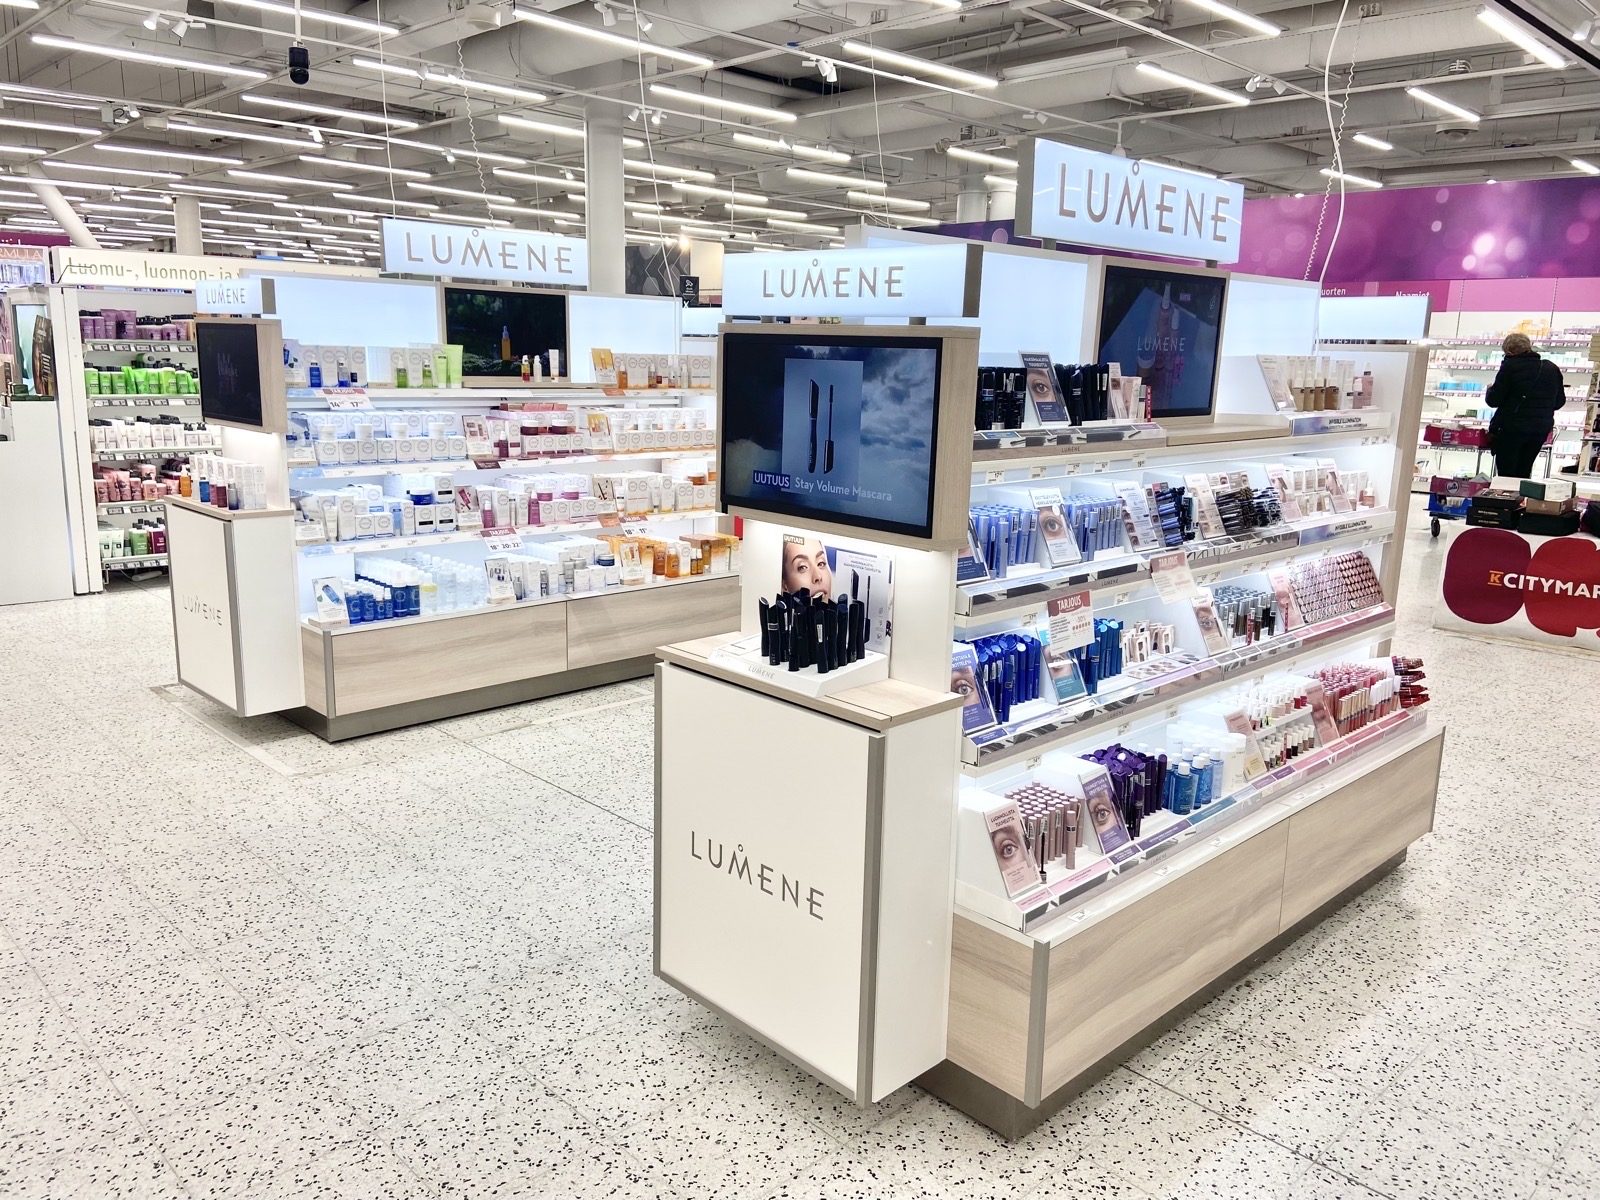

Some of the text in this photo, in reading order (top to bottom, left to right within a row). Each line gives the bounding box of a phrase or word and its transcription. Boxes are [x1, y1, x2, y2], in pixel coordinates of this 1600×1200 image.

[1059, 161, 1230, 243] LUMENE
[406, 229, 573, 274] LUMENE
[762, 258, 904, 298] LUMENE
[206, 285, 246, 304] LUMENE
[1137, 334, 1186, 352] LUMENE
[754, 472, 790, 487] UUTUUS
[795, 477, 892, 501] Stay Volume Mascara
[182, 595, 222, 626] LUMENE
[1057, 595, 1082, 610] TARJOUS
[691, 830, 824, 921] LUMENE
